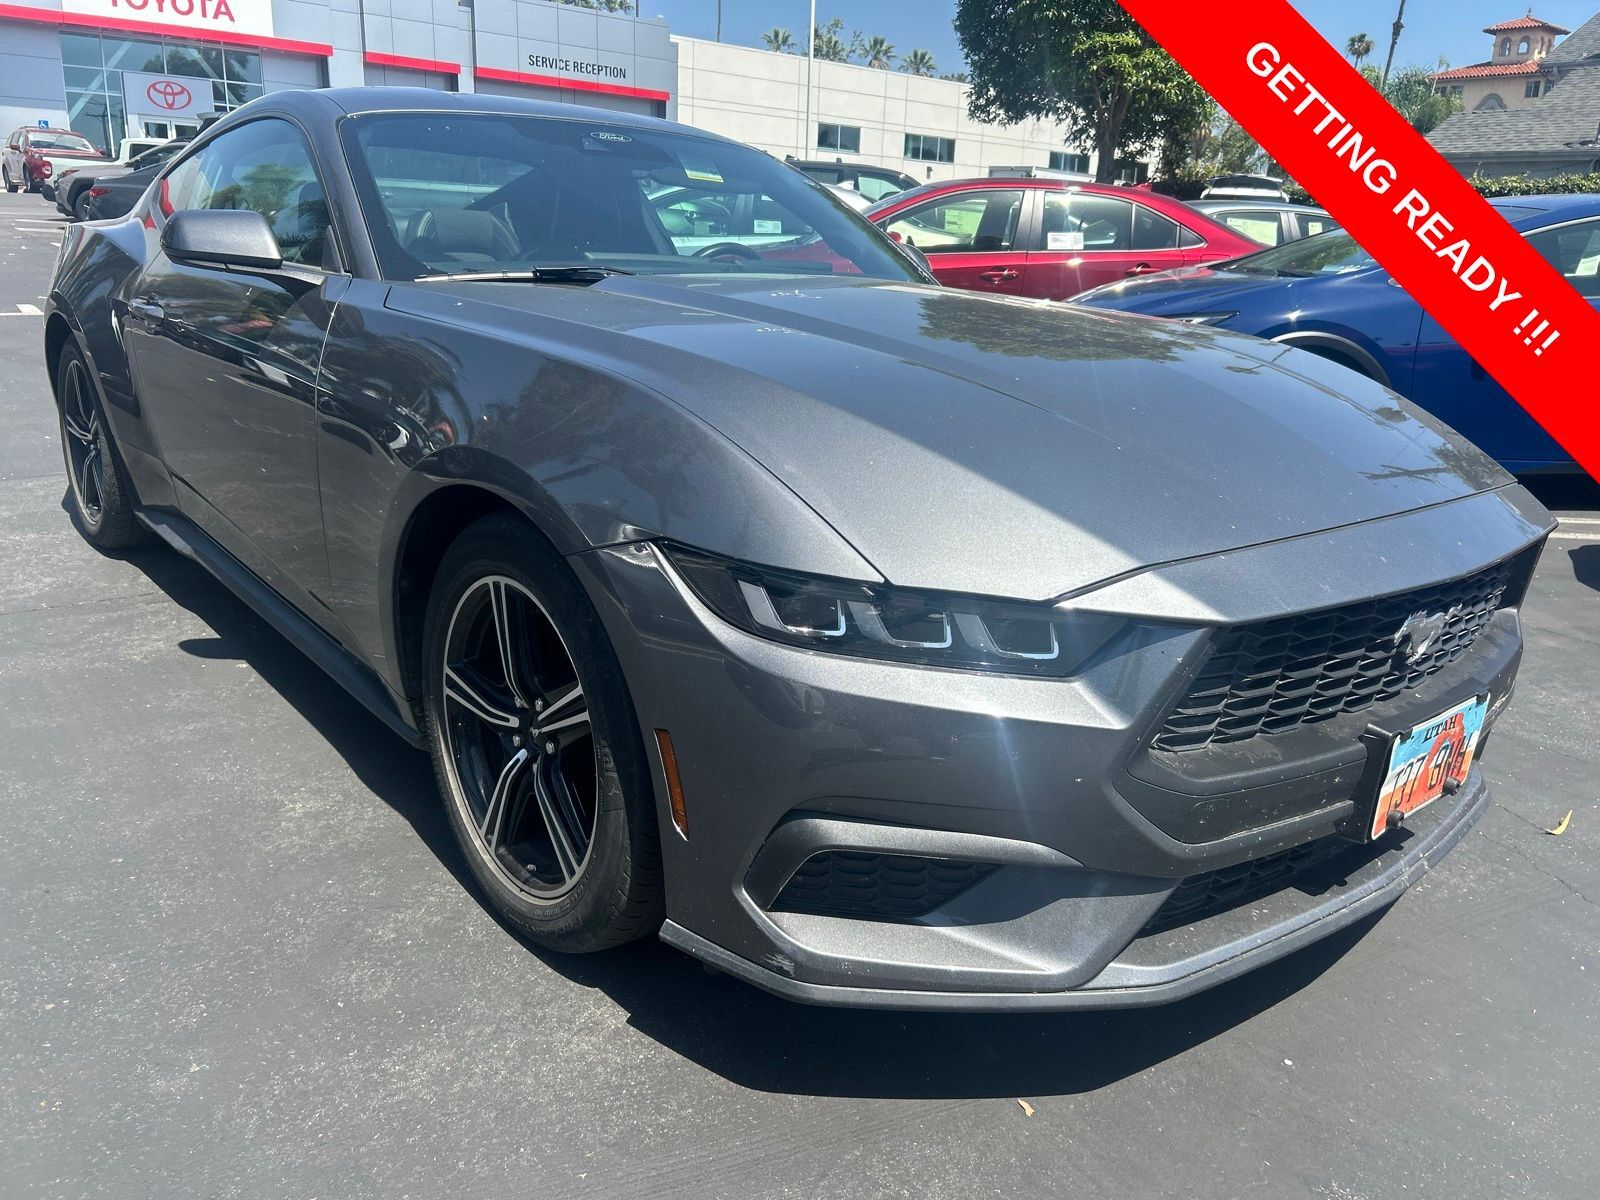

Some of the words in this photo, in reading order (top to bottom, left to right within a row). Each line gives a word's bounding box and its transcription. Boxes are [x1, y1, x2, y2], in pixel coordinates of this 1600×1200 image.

[111, 0, 235, 22] OYOTA
[528, 54, 570, 71] SERVICE
[573, 61, 626, 79] RECEPTION
[599, 132, 625, 141] Ford
[1422, 713, 1459, 744] UTAH
